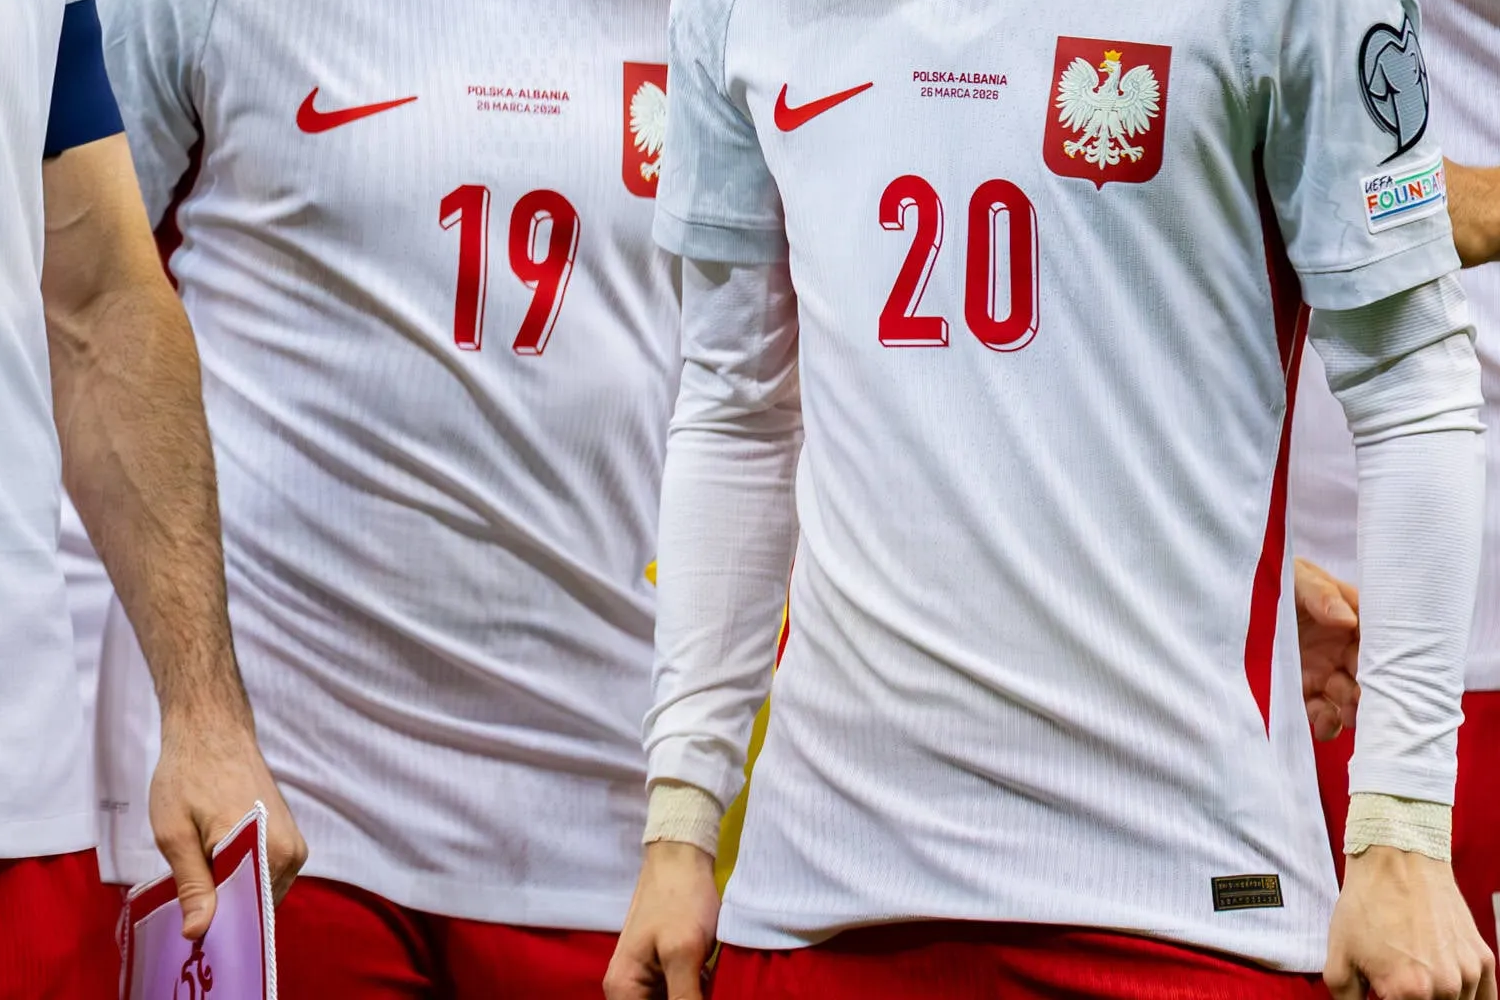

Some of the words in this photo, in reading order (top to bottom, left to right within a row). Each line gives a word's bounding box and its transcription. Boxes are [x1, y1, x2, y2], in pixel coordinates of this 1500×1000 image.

[912, 71, 1008, 86] POLSKA-ALBANIA
[920, 86, 933, 97] 26
[934, 87, 971, 99] MARCA
[972, 88, 999, 101] 2026
[492, 100, 531, 113] MARCA
[1365, 175, 1393, 194] UEFA
[438, 183, 581, 357] 19
[878, 174, 1040, 353] 20
